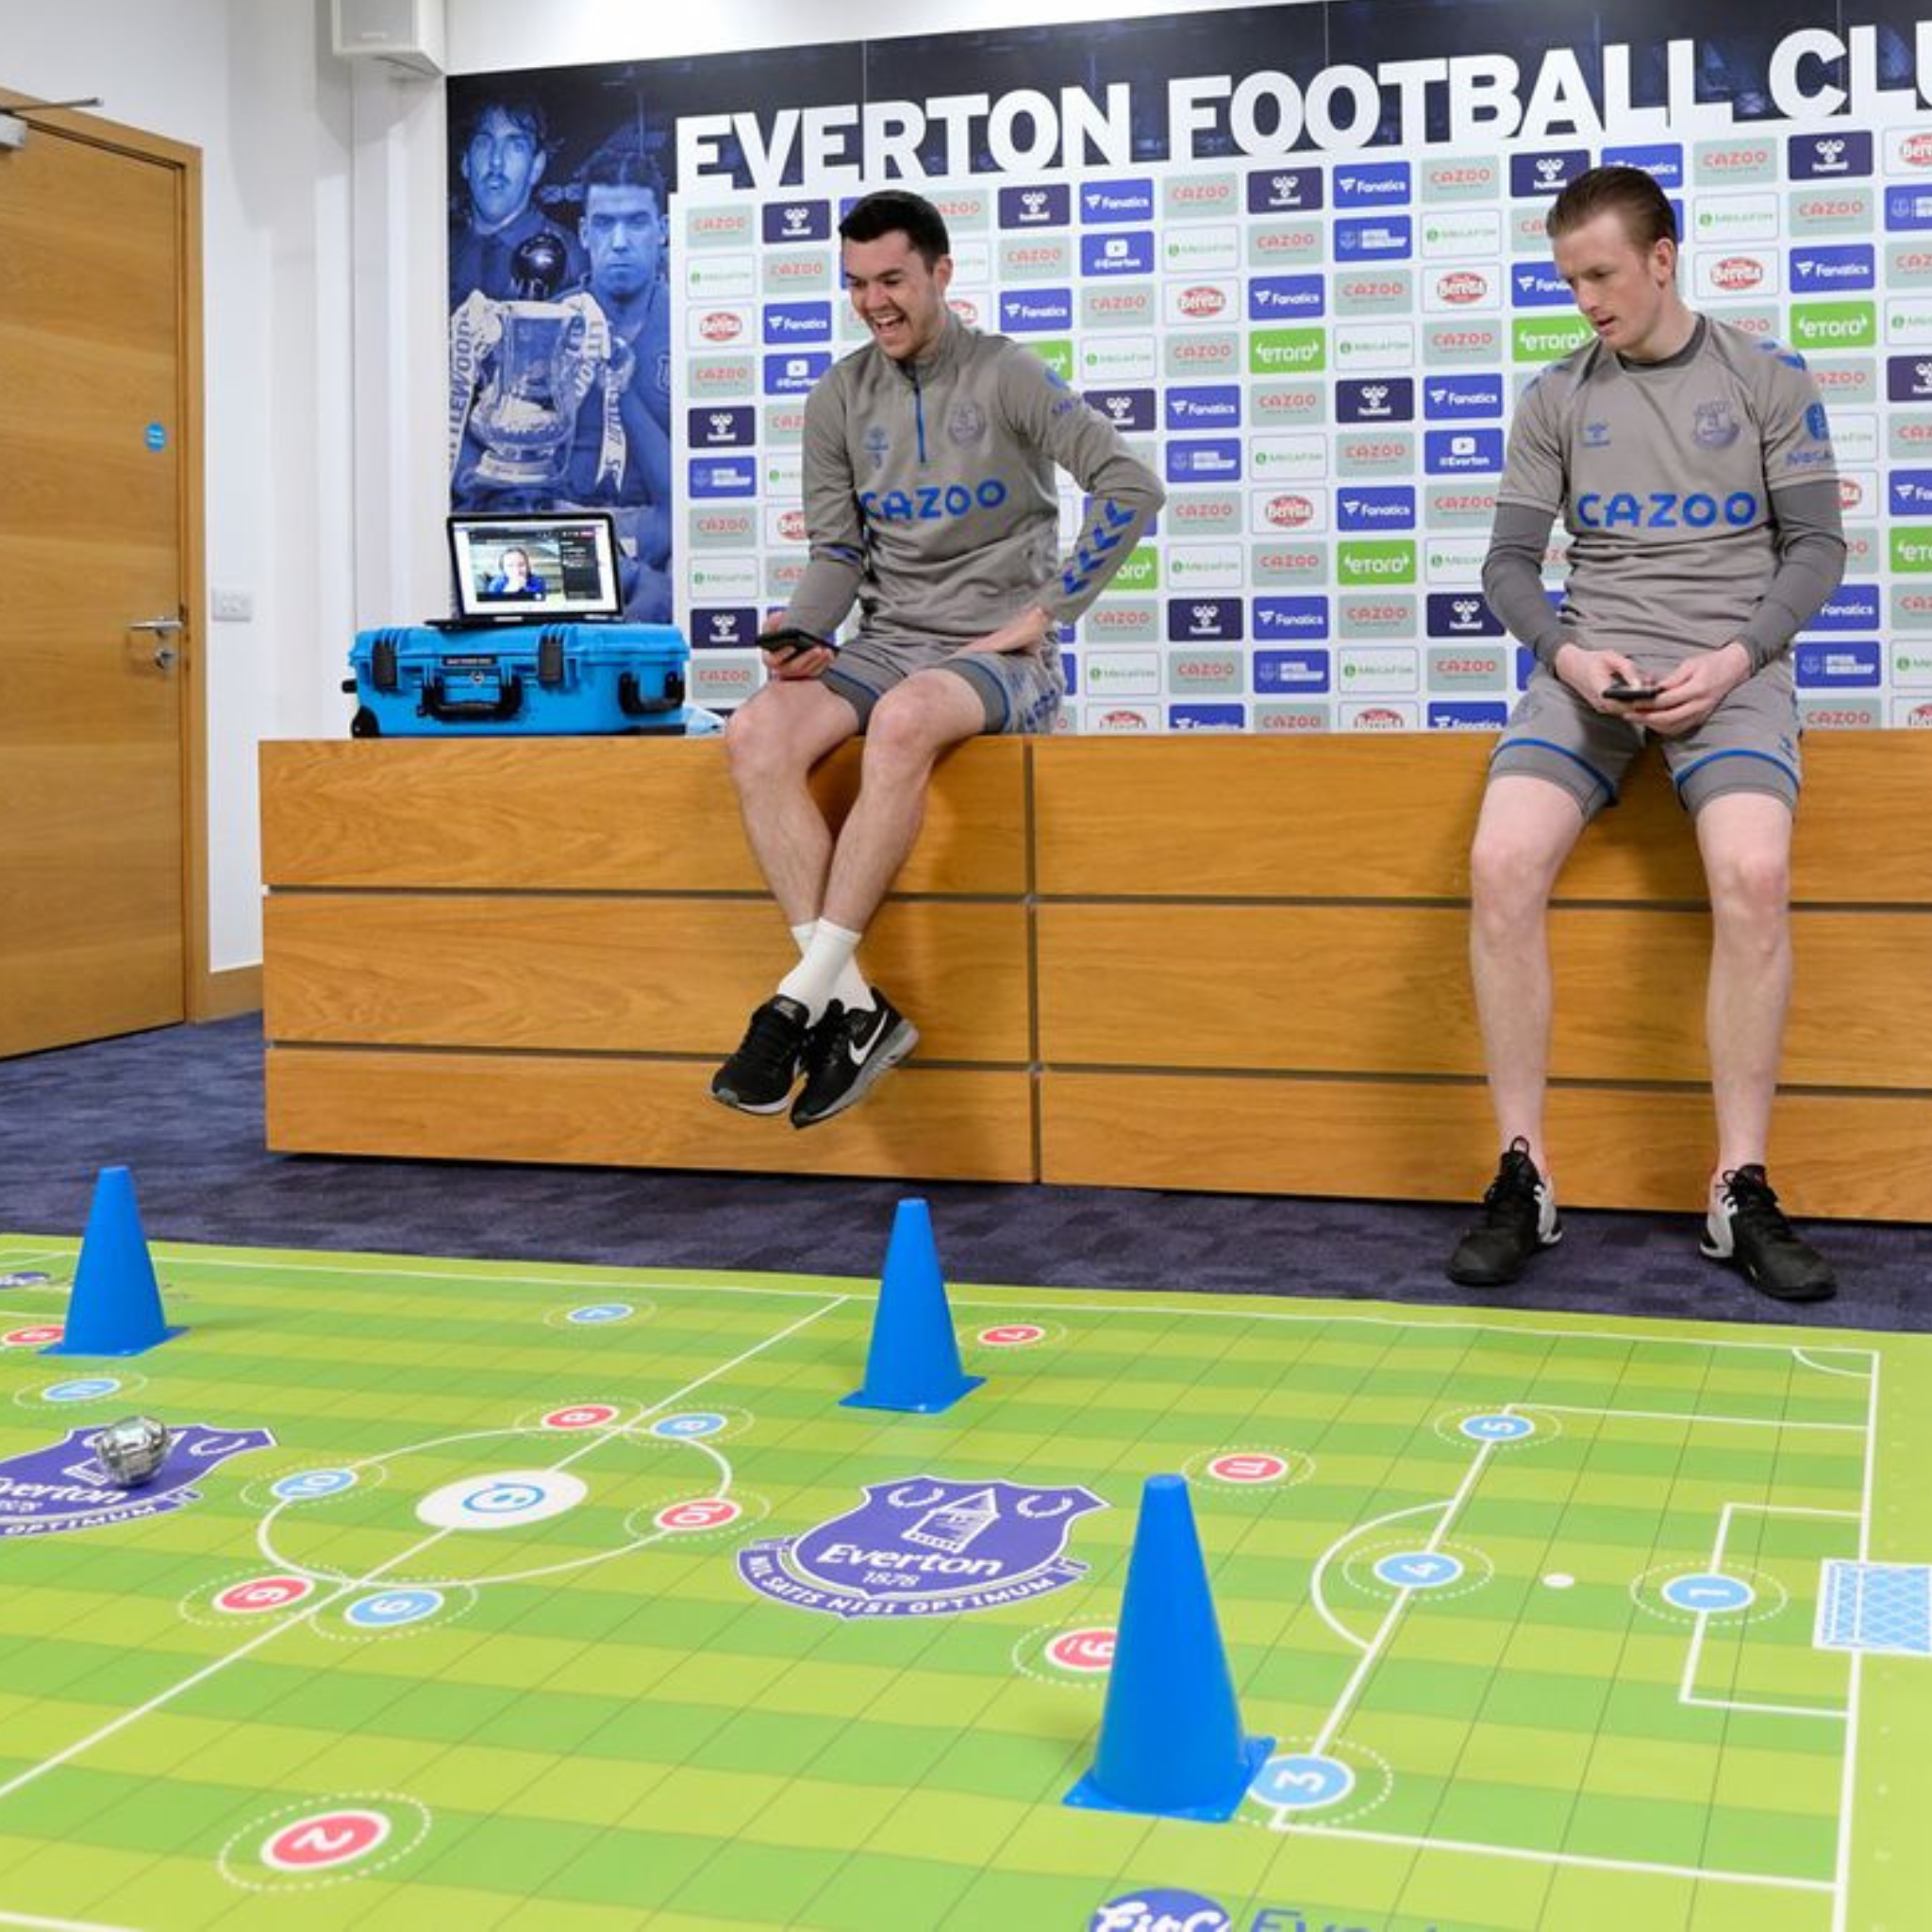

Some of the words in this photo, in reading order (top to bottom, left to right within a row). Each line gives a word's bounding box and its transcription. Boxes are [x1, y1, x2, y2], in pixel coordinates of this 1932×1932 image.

[677, 82, 1131, 190] EVERTON
[1168, 40, 1733, 158] FOOTBALL
[1769, 22, 1932, 121] CL
[1703, 151, 1767, 166] CAZOO
[1429, 169, 1491, 183] CAZOO
[1171, 186, 1229, 200] CAZOO
[1357, 179, 1406, 193] Fanatics
[935, 200, 981, 216] AZOO
[1102, 193, 1149, 210] Fanatics
[1799, 202, 1863, 216] CAZOO
[693, 215, 745, 231] CAZOO
[1257, 234, 1314, 248] CAZOO
[1007, 248, 1060, 263] CAZOO
[1896, 255, 1932, 268] CAZ
[771, 261, 823, 276] CAZOO
[1816, 262, 1869, 277] Fanatics
[1343, 283, 1404, 296] CAZOO
[1091, 294, 1148, 309] CAZOO
[1272, 291, 1320, 305] Fanatics
[1021, 303, 1067, 319] Fanatics
[783, 316, 827, 330] Fanatics
[1731, 319, 1771, 331] ZOO
[1432, 333, 1493, 346] CAZOO
[1175, 344, 1231, 358] CAZOO
[695, 367, 747, 381] CAZOO
[1813, 371, 1865, 384] AZOO
[1258, 394, 1316, 408] CAZOO
[1448, 391, 1497, 406] Fanatics
[1189, 401, 1236, 415] Fanatics
[772, 414, 804, 429] CAZ
[1897, 426, 1932, 441] CAZ
[1345, 444, 1405, 458] CAZOO
[860, 479, 1007, 520] CAZOO
[1435, 496, 1496, 509] CAZOO
[1176, 504, 1232, 517] CAZOO
[1361, 504, 1410, 517] Fanatics
[1577, 491, 1756, 527] CAZOO
[697, 517, 748, 534] CAZOO
[1260, 555, 1319, 568] CAZOO
[774, 567, 808, 580] CAZ
[1902, 597, 1932, 610] CAZ
[1093, 610, 1150, 625] CAZOO
[1275, 613, 1324, 625] Fanatics
[1347, 607, 1407, 620] CAZOO
[1177, 663, 1234, 676] CAZOO
[1437, 659, 1496, 673] CAZOO
[698, 668, 750, 682] CAZOO
[1262, 715, 1321, 728] CAZOO
[1807, 711, 1871, 724] CAZOO
[1482, 1420, 1515, 1434] 5
[817, 1543, 1003, 1575] Everton
[1401, 1561, 1441, 1576] 4
[862, 1571, 921, 1588] 1878
[827, 1597, 894, 1614] NISI
[908, 1577, 1056, 1613] OPTIMUM
[1690, 1589, 1731, 1600] 1
[1274, 1771, 1325, 1792] 3
[291, 1827, 354, 1852] 2
